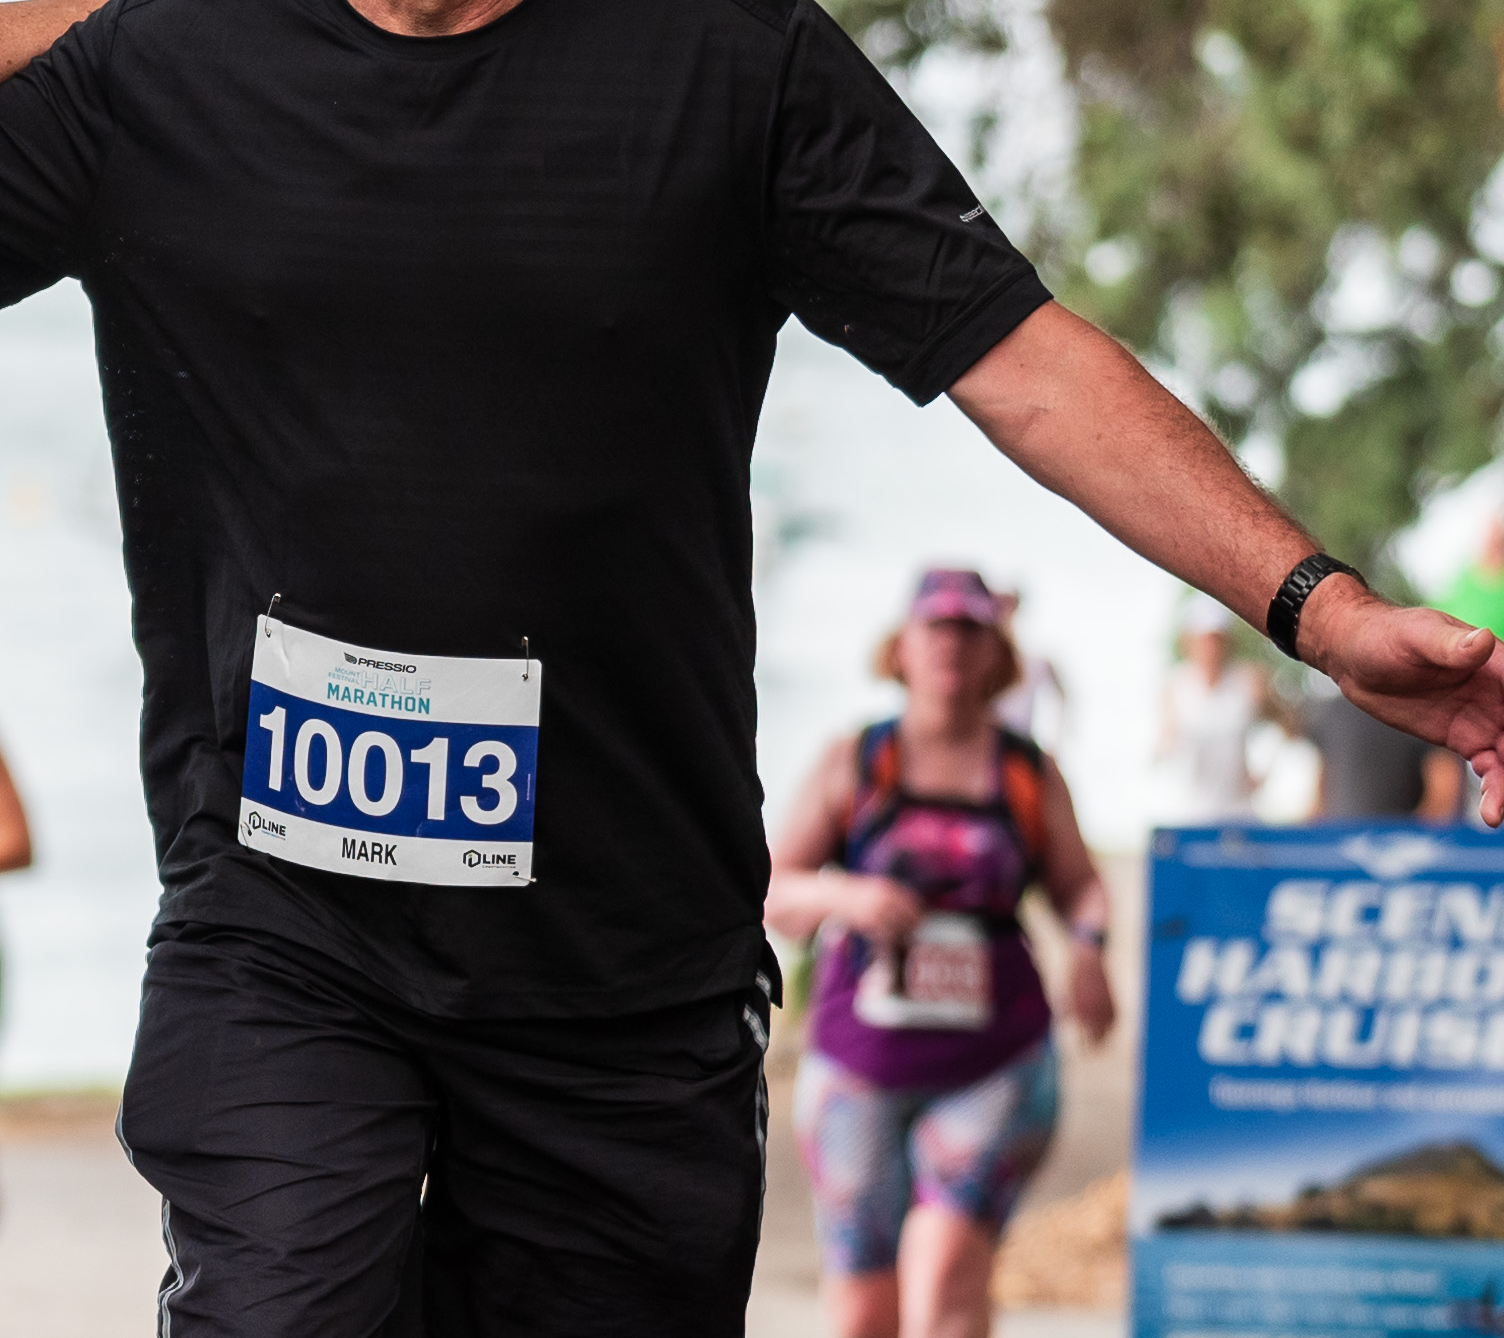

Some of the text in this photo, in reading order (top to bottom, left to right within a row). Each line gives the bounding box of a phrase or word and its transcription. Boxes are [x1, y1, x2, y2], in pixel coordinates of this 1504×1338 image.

[334, 667, 360, 677] MOUNT
[357, 657, 417, 674] PRESSIO
[361, 671, 432, 695] HALF
[327, 682, 430, 715] MARATHON
[259, 705, 518, 825] 10013
[341, 837, 398, 865] MARK
